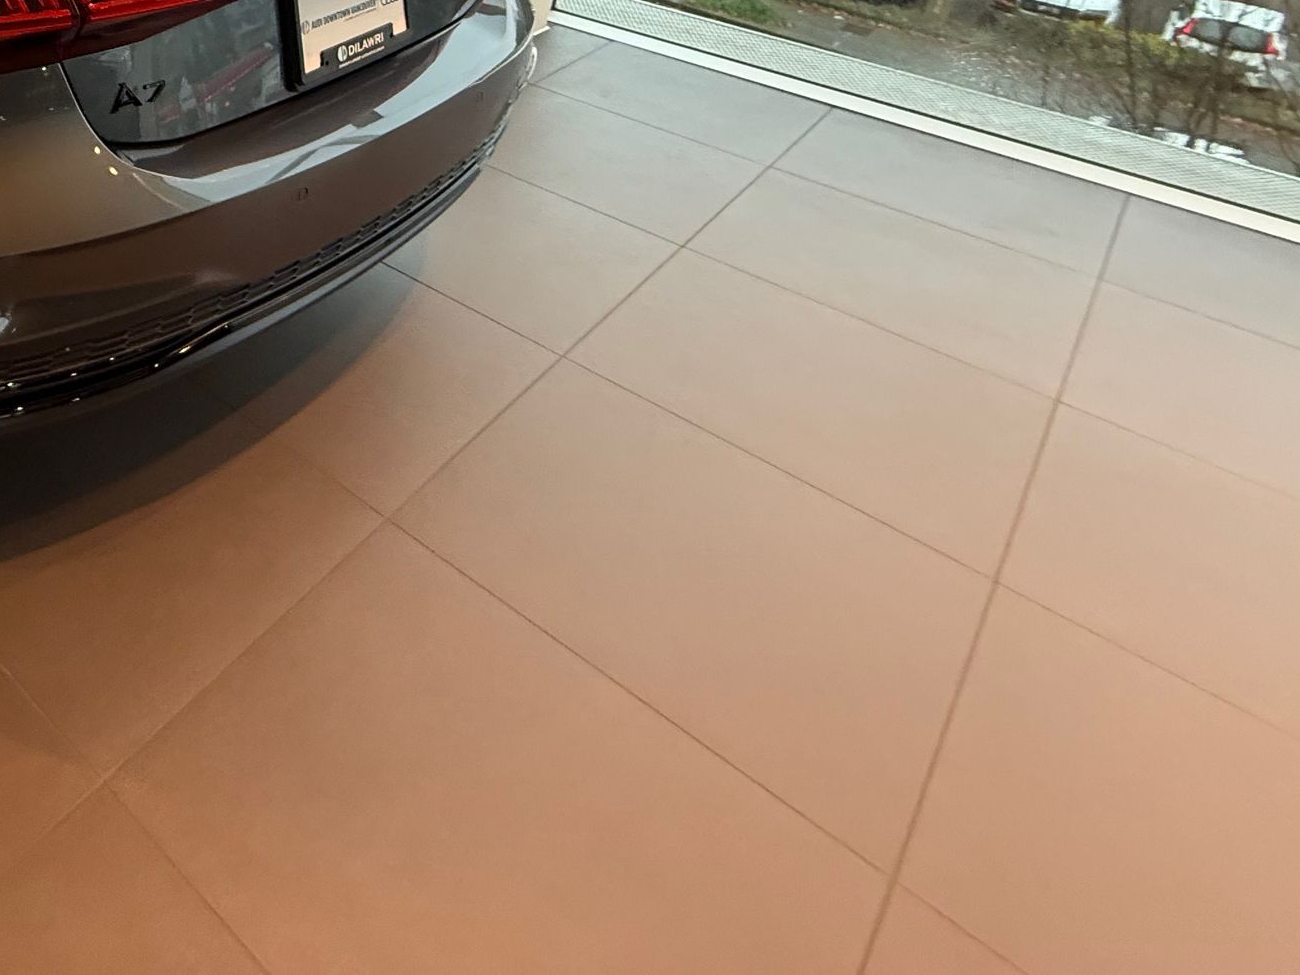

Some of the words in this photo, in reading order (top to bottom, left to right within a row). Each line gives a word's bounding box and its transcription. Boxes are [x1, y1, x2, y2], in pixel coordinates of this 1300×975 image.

[324, 8, 351, 25] DOWNTOWN
[348, 32, 384, 56] DILAWRI
[110, 79, 166, 114] A7
